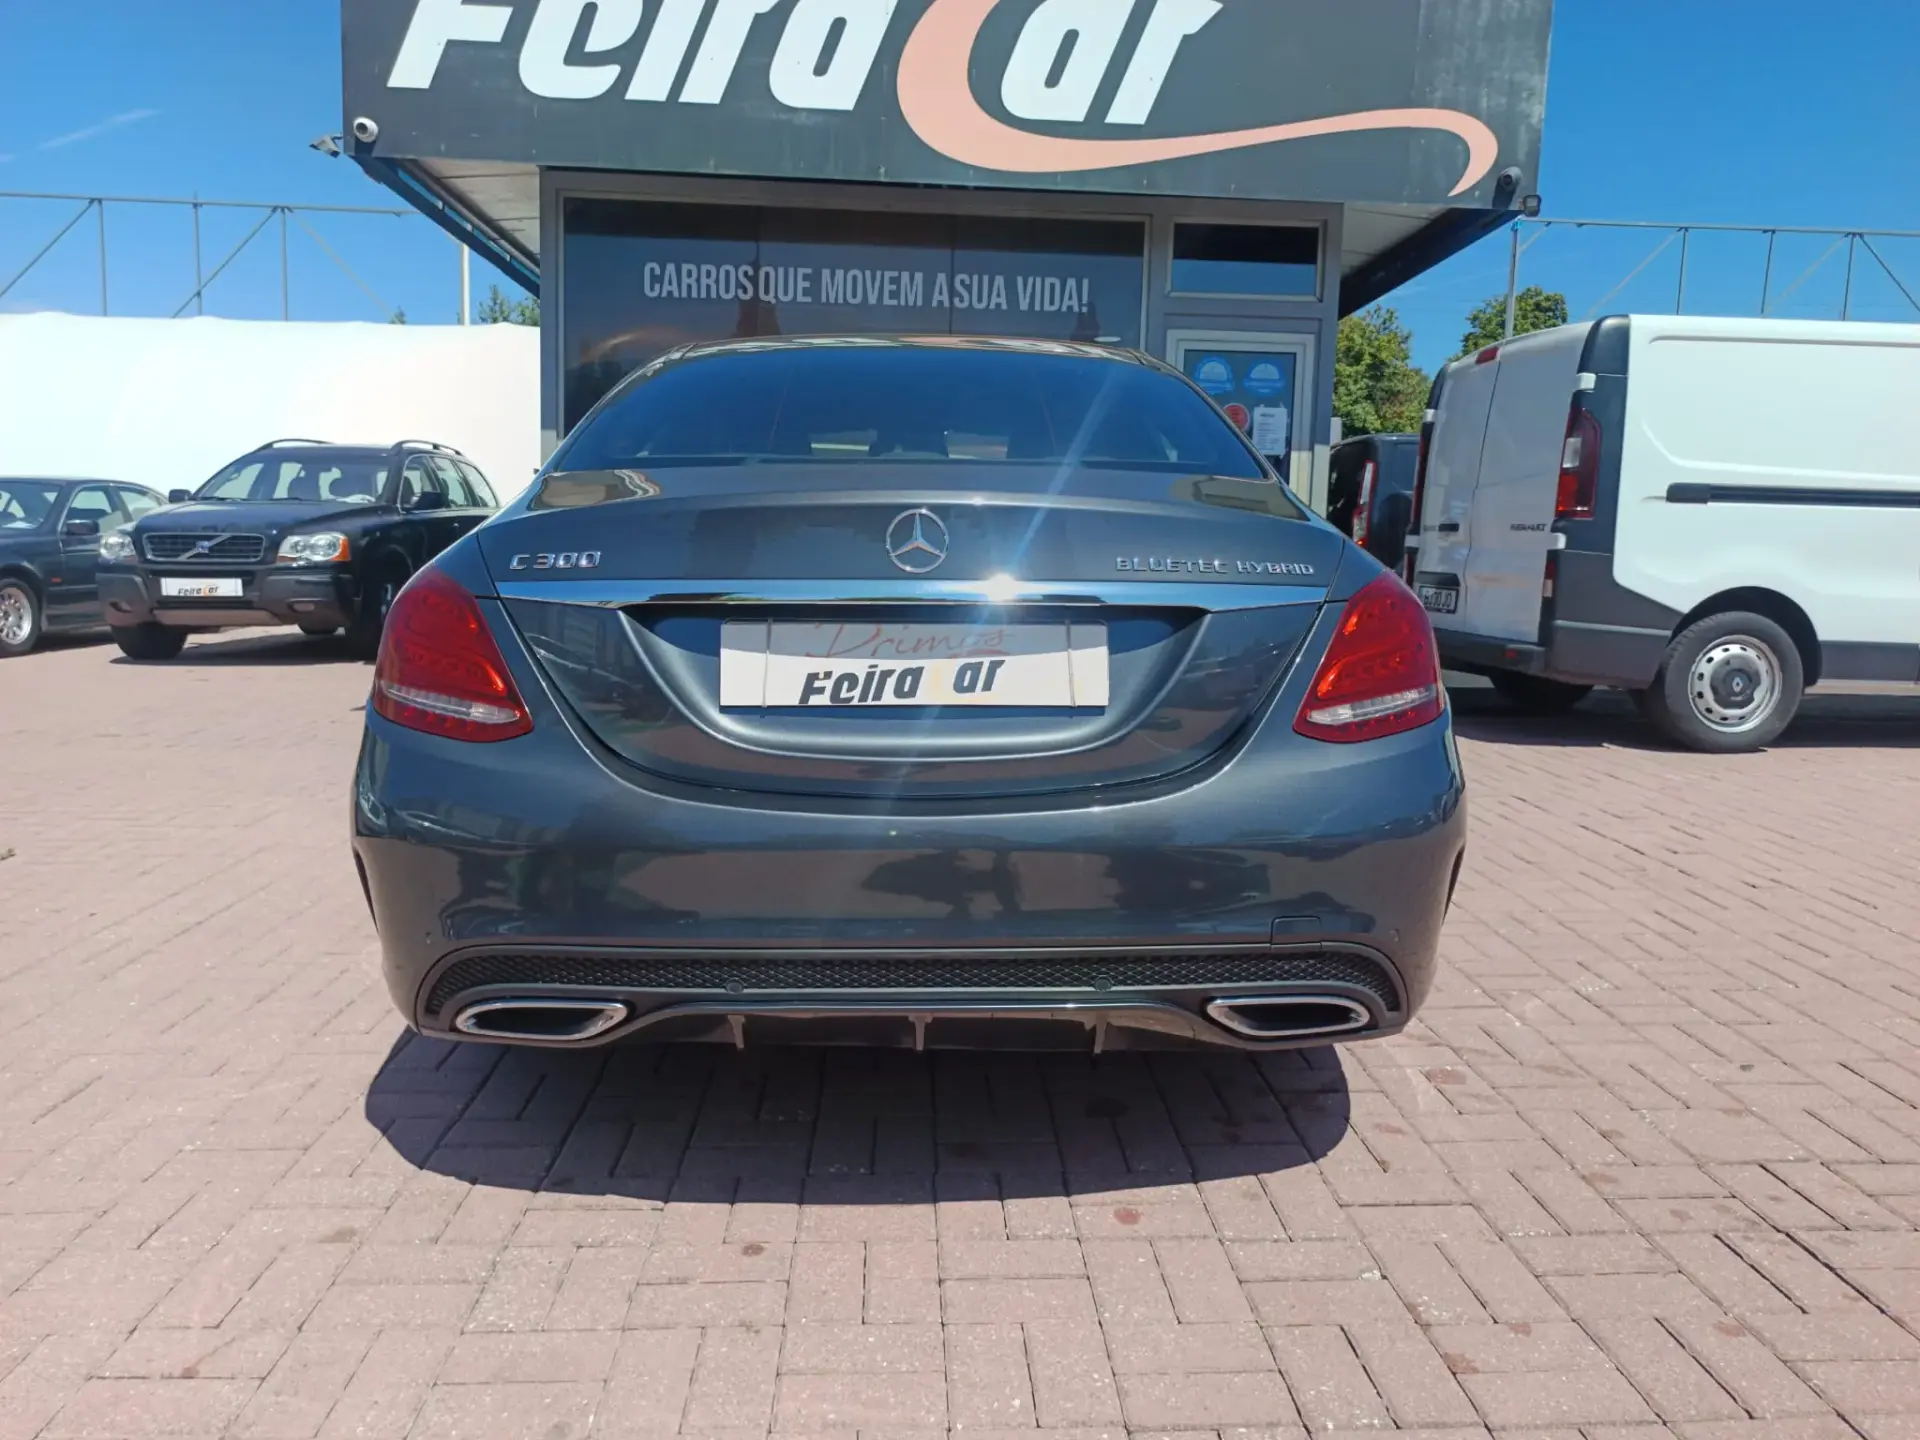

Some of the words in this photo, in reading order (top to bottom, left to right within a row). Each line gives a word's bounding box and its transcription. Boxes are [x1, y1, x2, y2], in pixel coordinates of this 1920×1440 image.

[643, 261, 754, 301] CARROS
[758, 265, 813, 304] QUE
[820, 268, 924, 307] MOVEM
[1016, 276, 1090, 313] VIDA!
[509, 554, 531, 570] C
[532, 551, 602, 569] 300
[1115, 556, 1229, 575] BLUETEC
[1236, 560, 1315, 576] HYBRID
